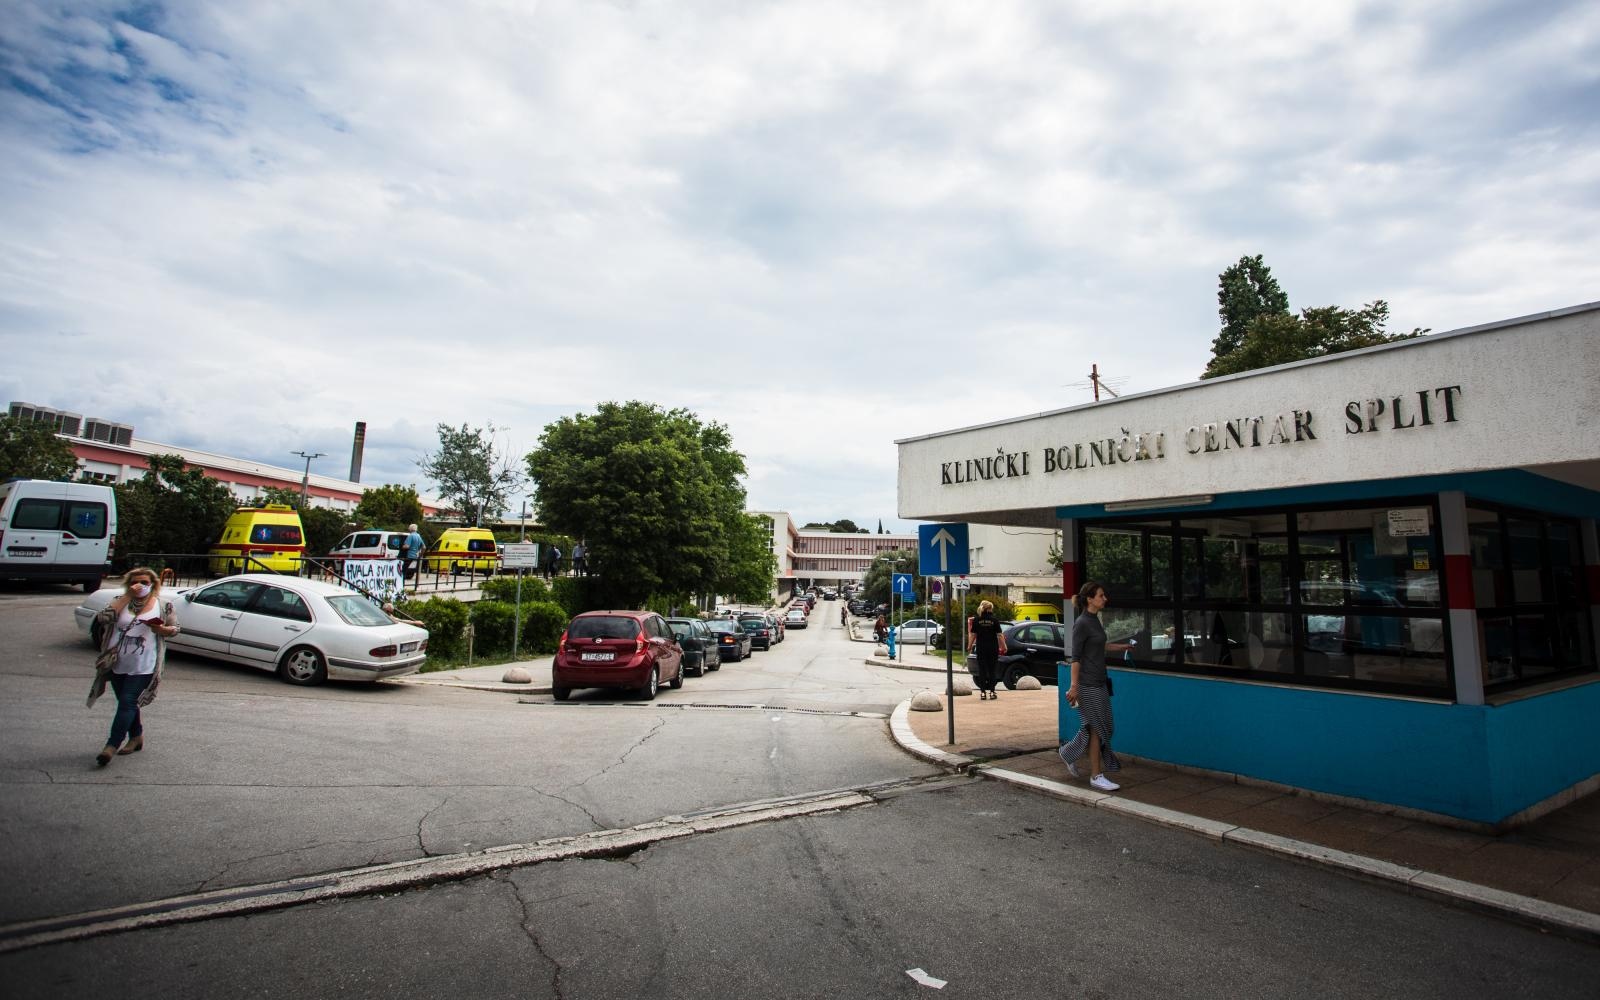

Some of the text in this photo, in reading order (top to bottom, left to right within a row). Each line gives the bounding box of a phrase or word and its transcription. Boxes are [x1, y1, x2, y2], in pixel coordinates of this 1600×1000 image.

[941, 385, 1462, 485] KLINIČKI BOLNIČKI CENTAR SPLIT
[346, 563, 394, 580] HVALA SVIM
